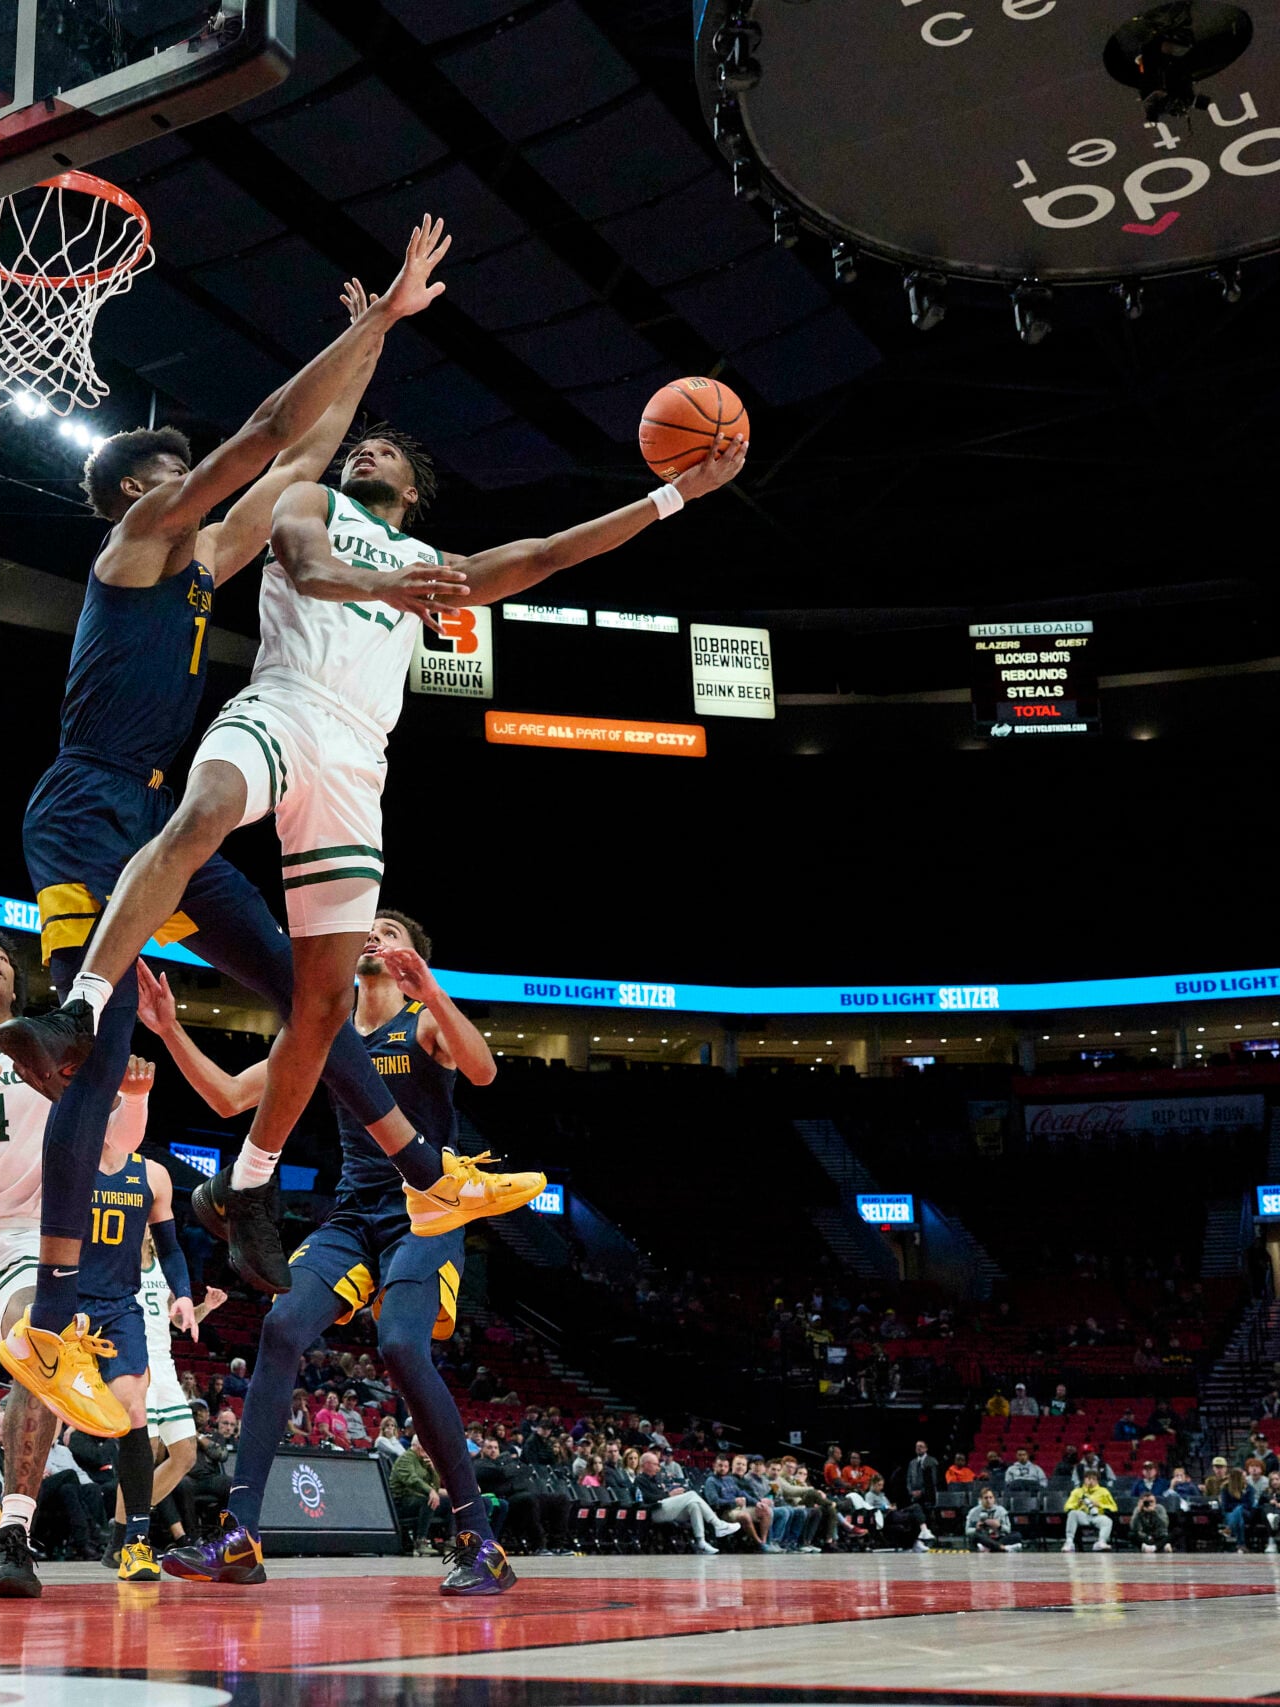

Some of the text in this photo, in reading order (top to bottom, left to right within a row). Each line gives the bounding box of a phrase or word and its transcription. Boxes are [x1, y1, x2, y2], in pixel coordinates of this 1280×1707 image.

[333, 534, 405, 570] VIKIN
[528, 605, 563, 615] HOME
[619, 612, 657, 623] GUEST
[977, 623, 1084, 635] HUSTLEBOARD
[709, 638, 769, 656] BARREL
[975, 641, 1020, 650] BLAZERS
[1055, 638, 1088, 647] GUEST
[421, 656, 482, 673] LORENTZ
[695, 653, 752, 669] BREWING
[995, 651, 1070, 664] BLOCKED SHOTS
[421, 670, 483, 689] BRUUN
[1001, 668, 1067, 681] REBOUNDS
[421, 686, 484, 696] CONSTRUCTION
[697, 683, 771, 700] DRINK BEER
[1007, 685, 1064, 698] STEALS
[1013, 705, 1061, 717] TOTAL
[494, 722, 696, 746] WE ARE ALL PART OF RIP CITY
[1175, 975, 1279, 996] BUD LIGHT
[523, 983, 676, 1008] BUD LIGHT SELTZER
[840, 986, 1000, 1010] BUD LIGHT SELTZER
[1152, 1110, 1175, 1125] RIP
[1179, 1108, 1210, 1122] CITY
[101, 1190, 144, 1208] VIRGINIA
[861, 1203, 910, 1221] SELTZER
[91, 1207, 125, 1245] 10
[145, 1292, 160, 1316] 5
